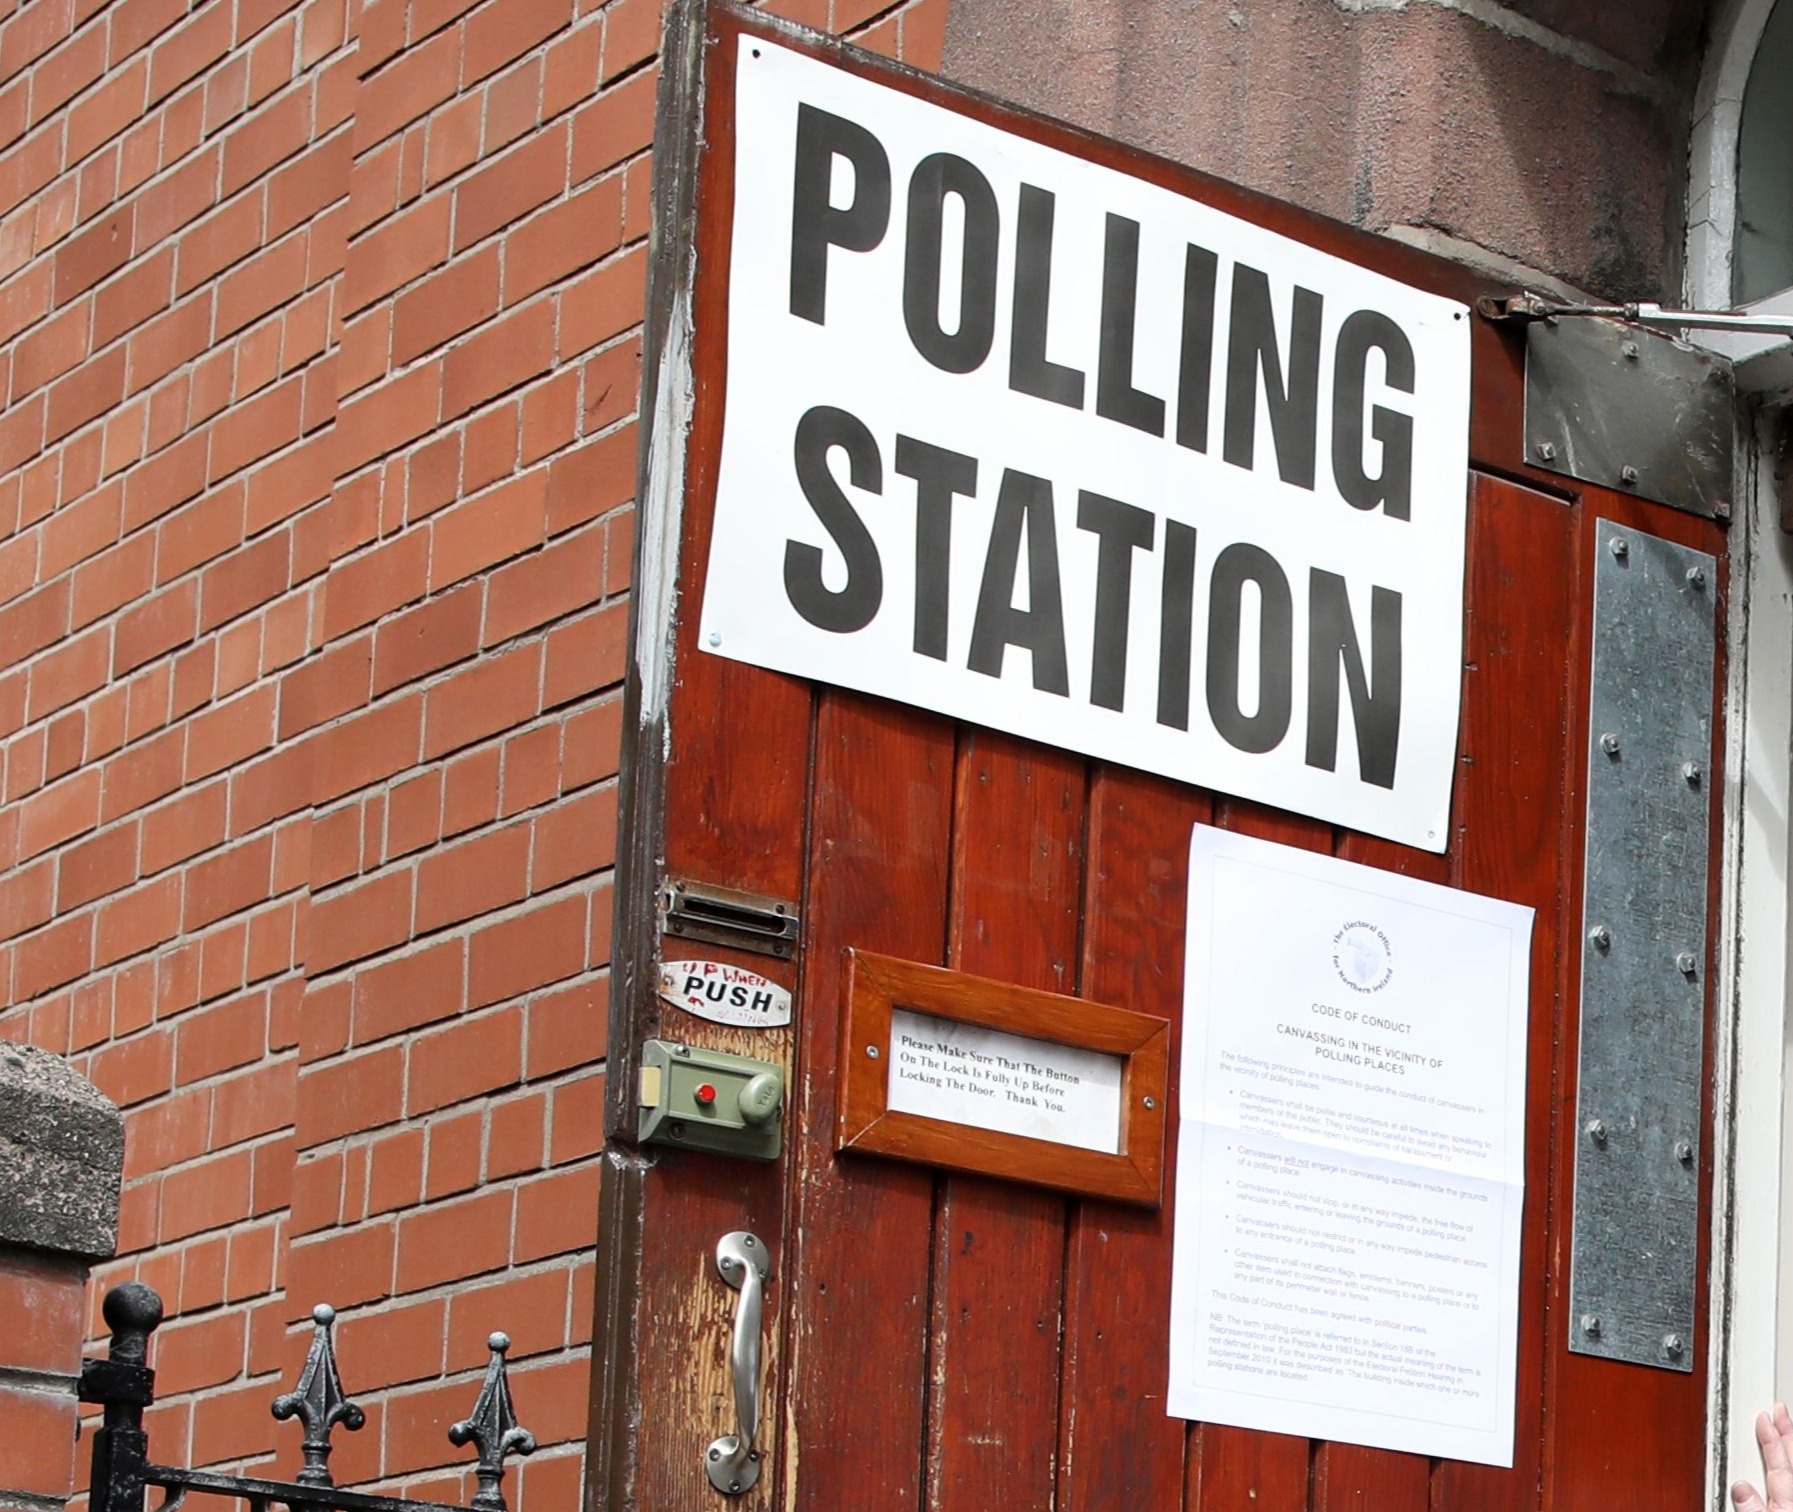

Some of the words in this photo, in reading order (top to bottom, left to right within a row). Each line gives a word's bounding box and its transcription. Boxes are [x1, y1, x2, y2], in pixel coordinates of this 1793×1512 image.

[790, 103, 1414, 521] POLLING
[784, 407, 1401, 789] STATION
[683, 976, 773, 1012] PUSH
[722, 968, 767, 987] WHEN
[1310, 1001, 1341, 1019] CODE
[1343, 1009, 1358, 1022] OF
[1360, 1013, 1412, 1035] CONDUCT
[900, 1034, 934, 1051] Please
[935, 1041, 967, 1058] Make
[968, 1048, 993, 1064] Sure
[995, 1055, 1020, 1070] That
[1022, 1061, 1042, 1075] The
[1045, 1067, 1079, 1083] Button
[1276, 1022, 1345, 1048] CANVASSING
[1347, 1039, 1359, 1050] IN
[1361, 1041, 1381, 1056] THE
[1383, 1047, 1427, 1066] VICINITY
[1428, 1055, 1444, 1070] OF
[1314, 1045, 1361, 1065] POLLING
[1363, 1056, 1405, 1075] PLACES
[899, 1051, 916, 1063] On
[919, 1055, 939, 1069] The
[943, 1060, 969, 1075] Lock
[972, 1066, 981, 1077] Is
[985, 1069, 1009, 1086] Fully
[1014, 1076, 1029, 1090] Up
[1032, 1080, 1064, 1096] Before
[899, 1067, 941, 1087] Locking
[945, 1077, 965, 1090] The
[968, 1082, 994, 1096] Door.
[1005, 1090, 1037, 1106] Thank
[1044, 1098, 1065, 1112] You.
